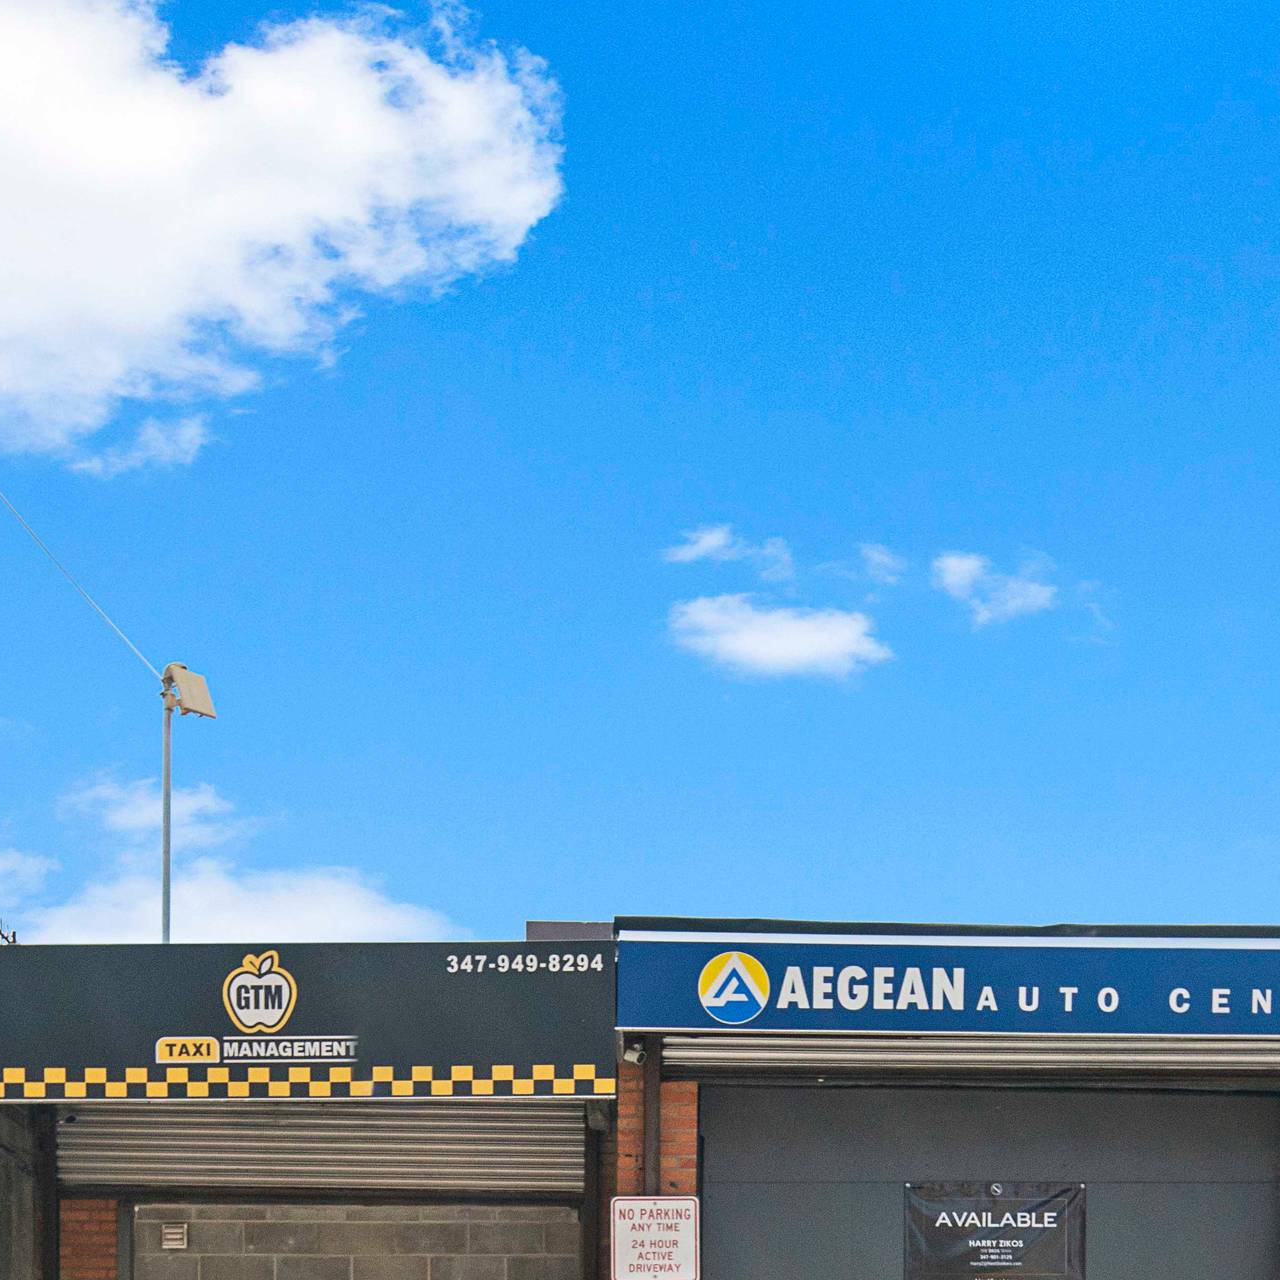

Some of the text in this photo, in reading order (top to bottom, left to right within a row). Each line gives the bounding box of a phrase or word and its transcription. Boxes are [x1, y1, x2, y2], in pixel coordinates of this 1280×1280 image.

[446, 953, 604, 973] 347-949-8294
[776, 965, 965, 1011] AEGEAN
[976, 986, 1120, 1012] AUTO
[236, 984, 283, 1010] GTM
[165, 1040, 358, 1058] TAXI MANAGEMENT
[618, 1208, 691, 1220] NO PARKING
[935, 1211, 1058, 1228] AVAILABLE
[630, 1222, 680, 1232] ANY TIME
[631, 1239, 679, 1249] 24 HOUR
[968, 1239, 1024, 1248] HARRY ZIKOS
[637, 1251, 673, 1261] ACTIVE
[628, 1263, 682, 1273] DRIVEWAY
